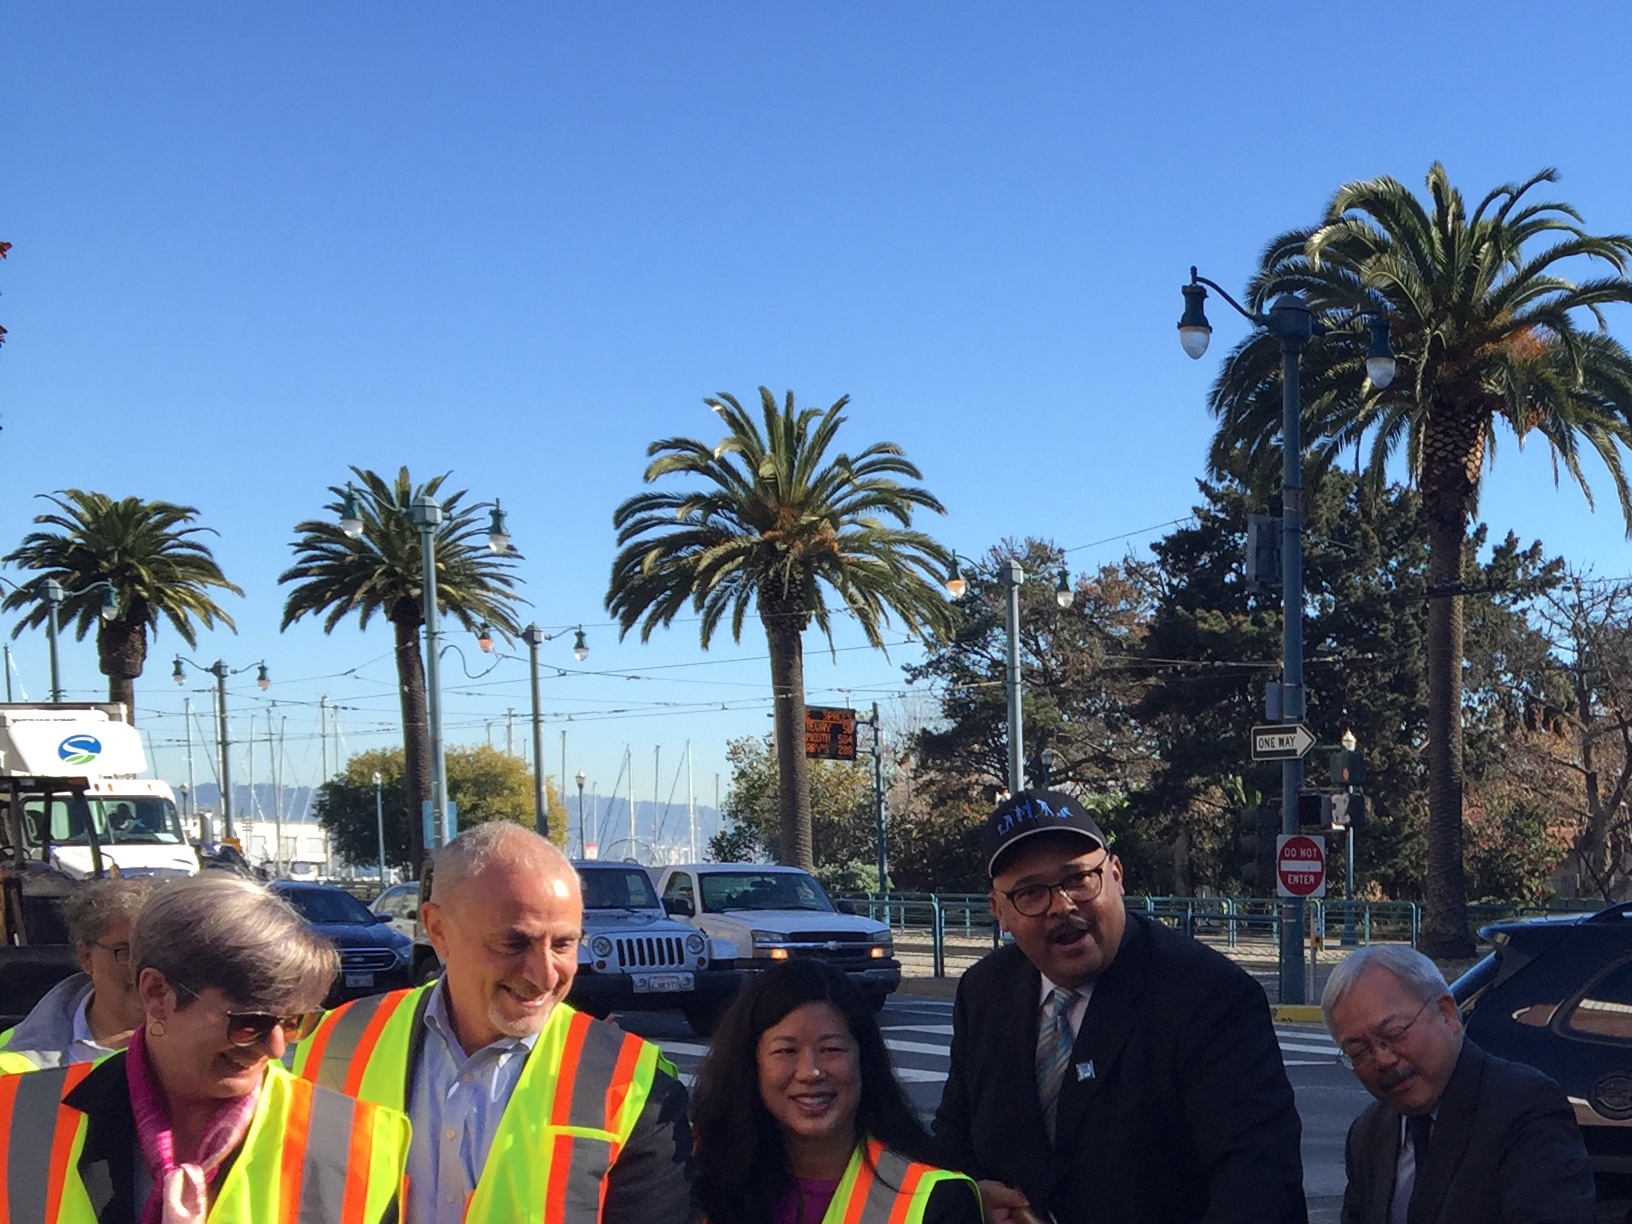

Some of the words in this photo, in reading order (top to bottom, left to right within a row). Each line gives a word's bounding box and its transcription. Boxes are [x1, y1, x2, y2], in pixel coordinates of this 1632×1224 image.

[1258, 736, 1276, 750] ONE
[1278, 736, 1296, 748] WAY
[1284, 848, 1297, 858] DO
[1300, 848, 1318, 858] NOT
[1288, 874, 1314, 885] ENTER
